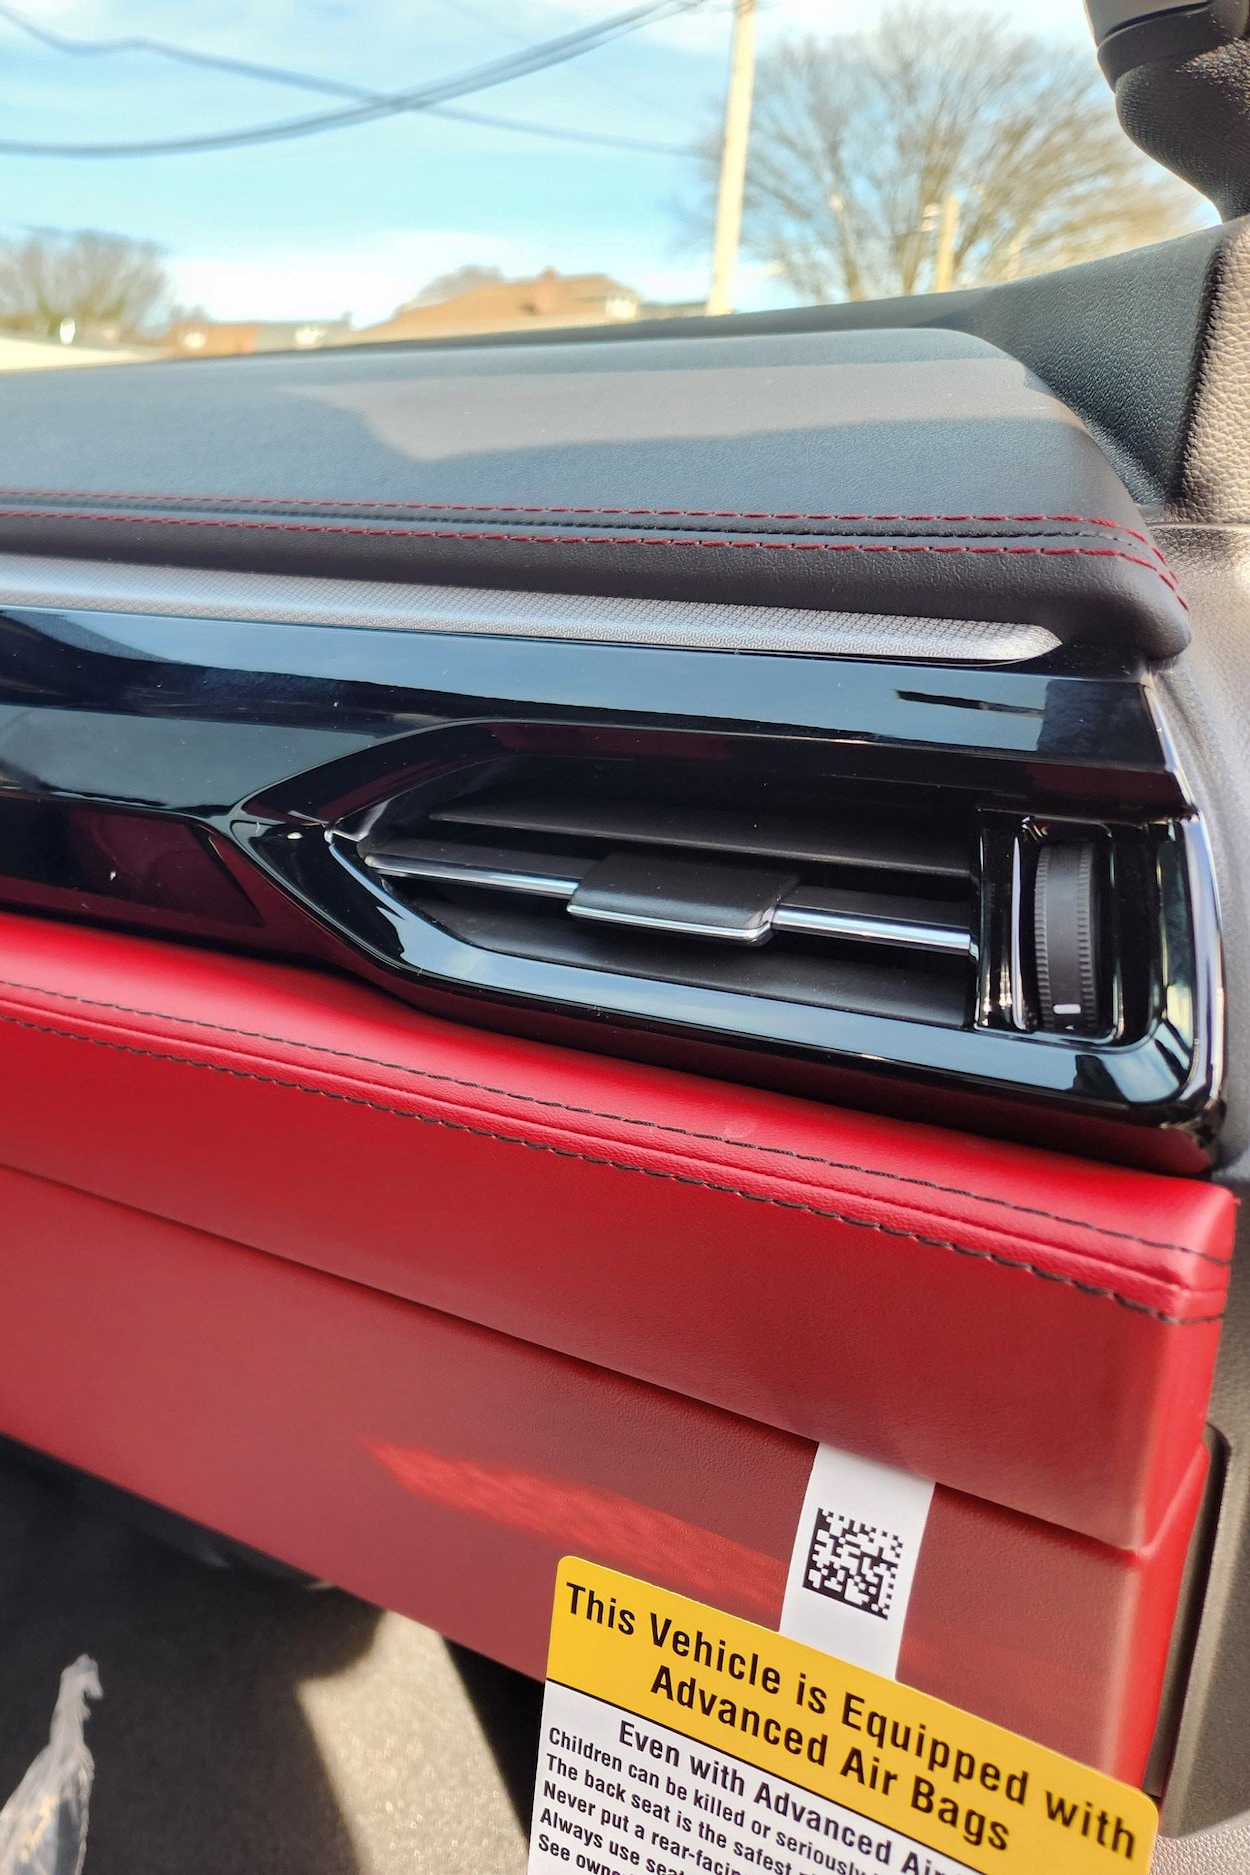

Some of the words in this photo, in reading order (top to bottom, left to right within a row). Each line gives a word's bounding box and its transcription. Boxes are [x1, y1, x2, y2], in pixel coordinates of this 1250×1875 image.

[566, 1581, 636, 1636] This
[650, 1612, 781, 1695] Vehicle
[796, 1672, 827, 1715] is
[841, 1692, 1029, 1806] Equipped
[1045, 1790, 1136, 1860] with
[650, 1664, 828, 1767] Advanced
[840, 1747, 898, 1796] Air
[911, 1775, 1009, 1851] Bags
[543, 1780, 596, 1817] Never
[600, 1808, 630, 1833] put
[634, 1824, 645, 1840] a
[546, 1753, 578, 1781] The
[584, 1769, 627, 1803] back
[631, 1793, 671, 1823] seat
[676, 1811, 692, 1832] is
[698, 1821, 727, 1849] the
[549, 1727, 622, 1772] Children
[628, 1764, 660, 1789] can
[665, 1776, 688, 1801] be
[693, 1788, 745, 1828] killed
[751, 1820, 771, 1839] or
[619, 1720, 680, 1768] Even
[689, 1755, 745, 1797] with
[753, 1781, 892, 1865] Advanced
[901, 1851, 946, 1875] Ai
[538, 1833, 571, 1861] See
[539, 1807, 603, 1849] Always
[608, 1840, 640, 1866] use
